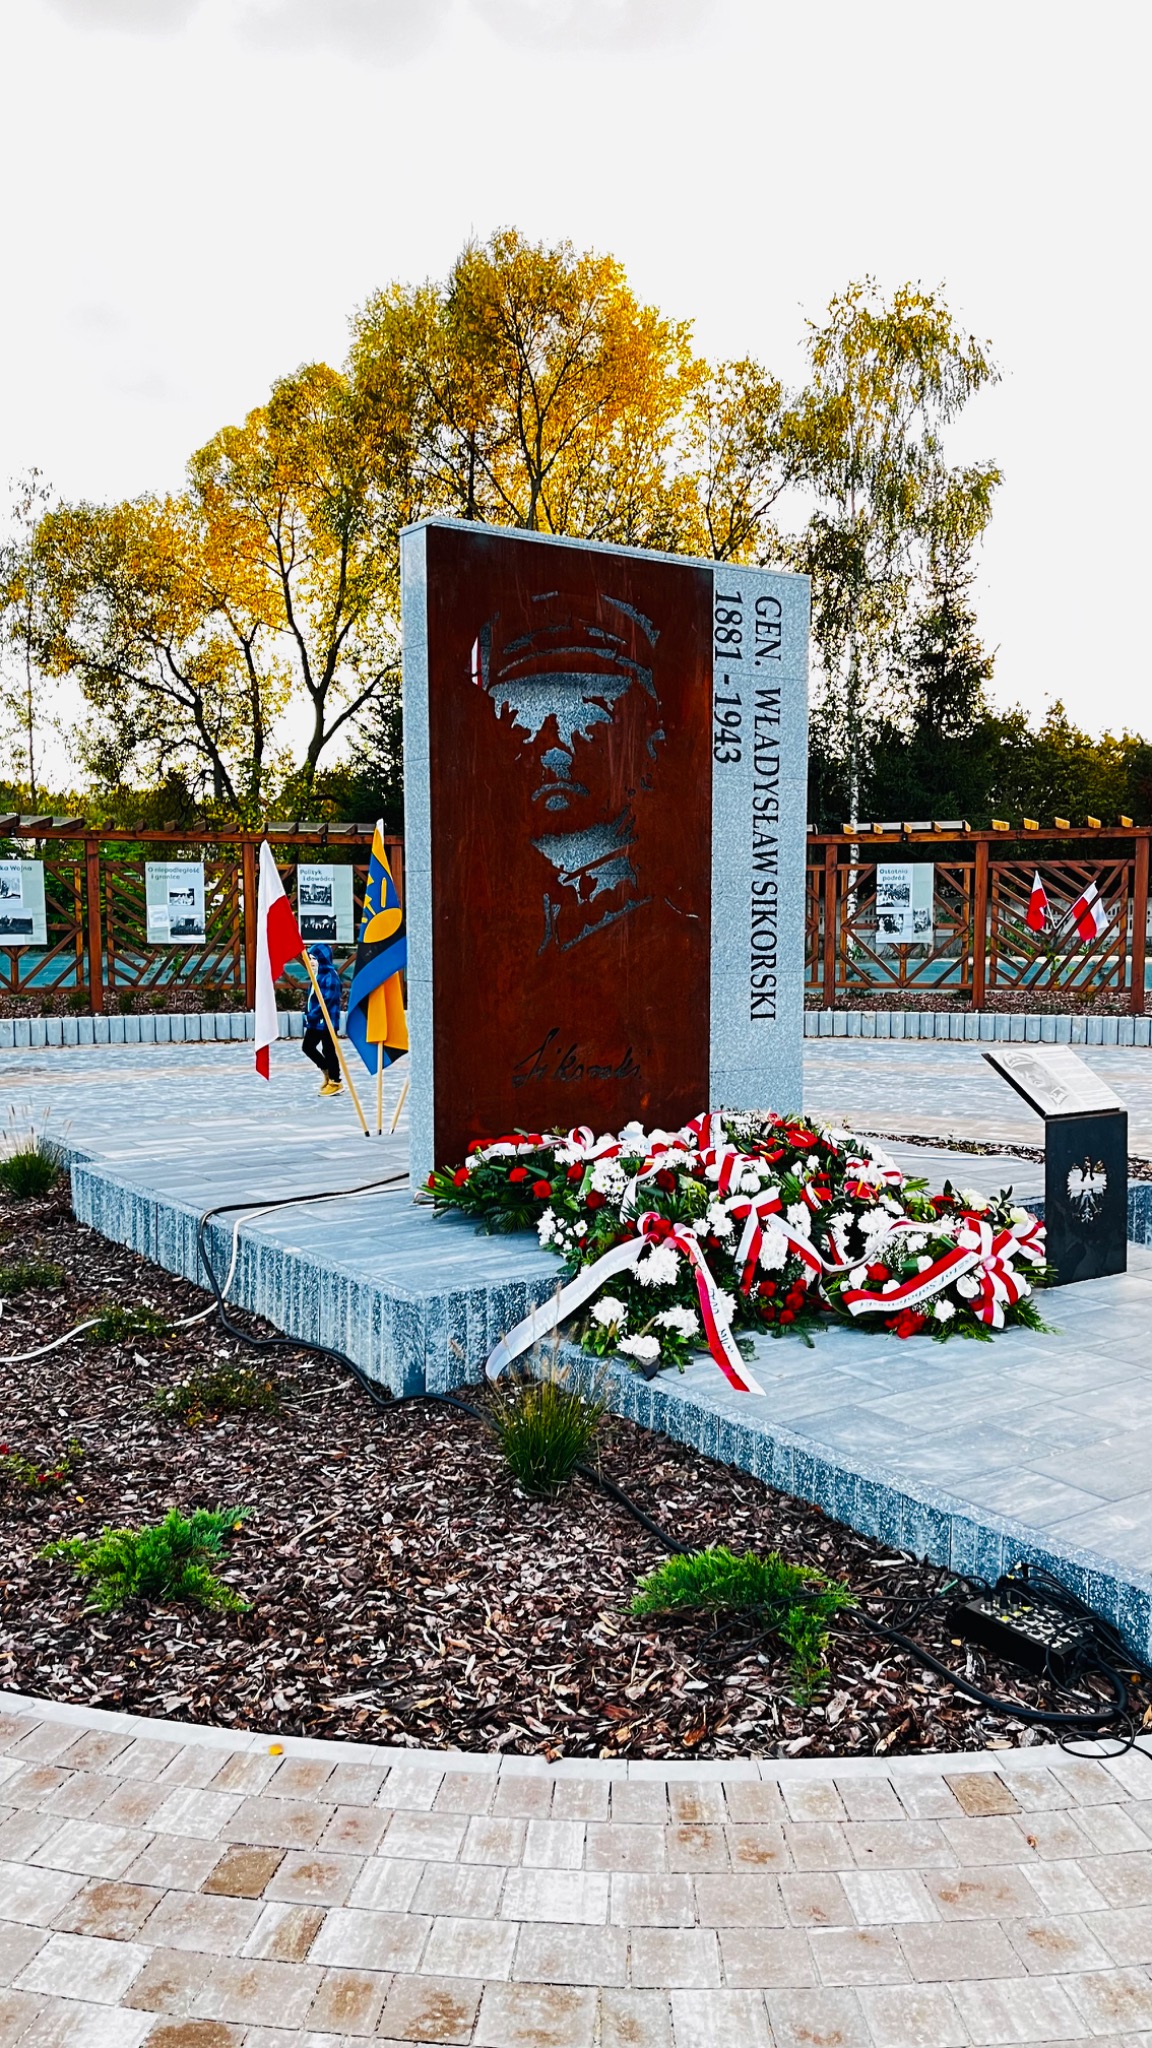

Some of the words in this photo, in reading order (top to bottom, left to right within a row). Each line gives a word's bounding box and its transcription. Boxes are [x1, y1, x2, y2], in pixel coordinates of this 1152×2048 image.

[714, 589, 744, 662] 1881
[754, 595, 782, 667] GEN.
[713, 692, 743, 764] 1943
[752, 687, 781, 875] WŁADYSŁAW
[750, 881, 778, 1021] SIKORSKI
